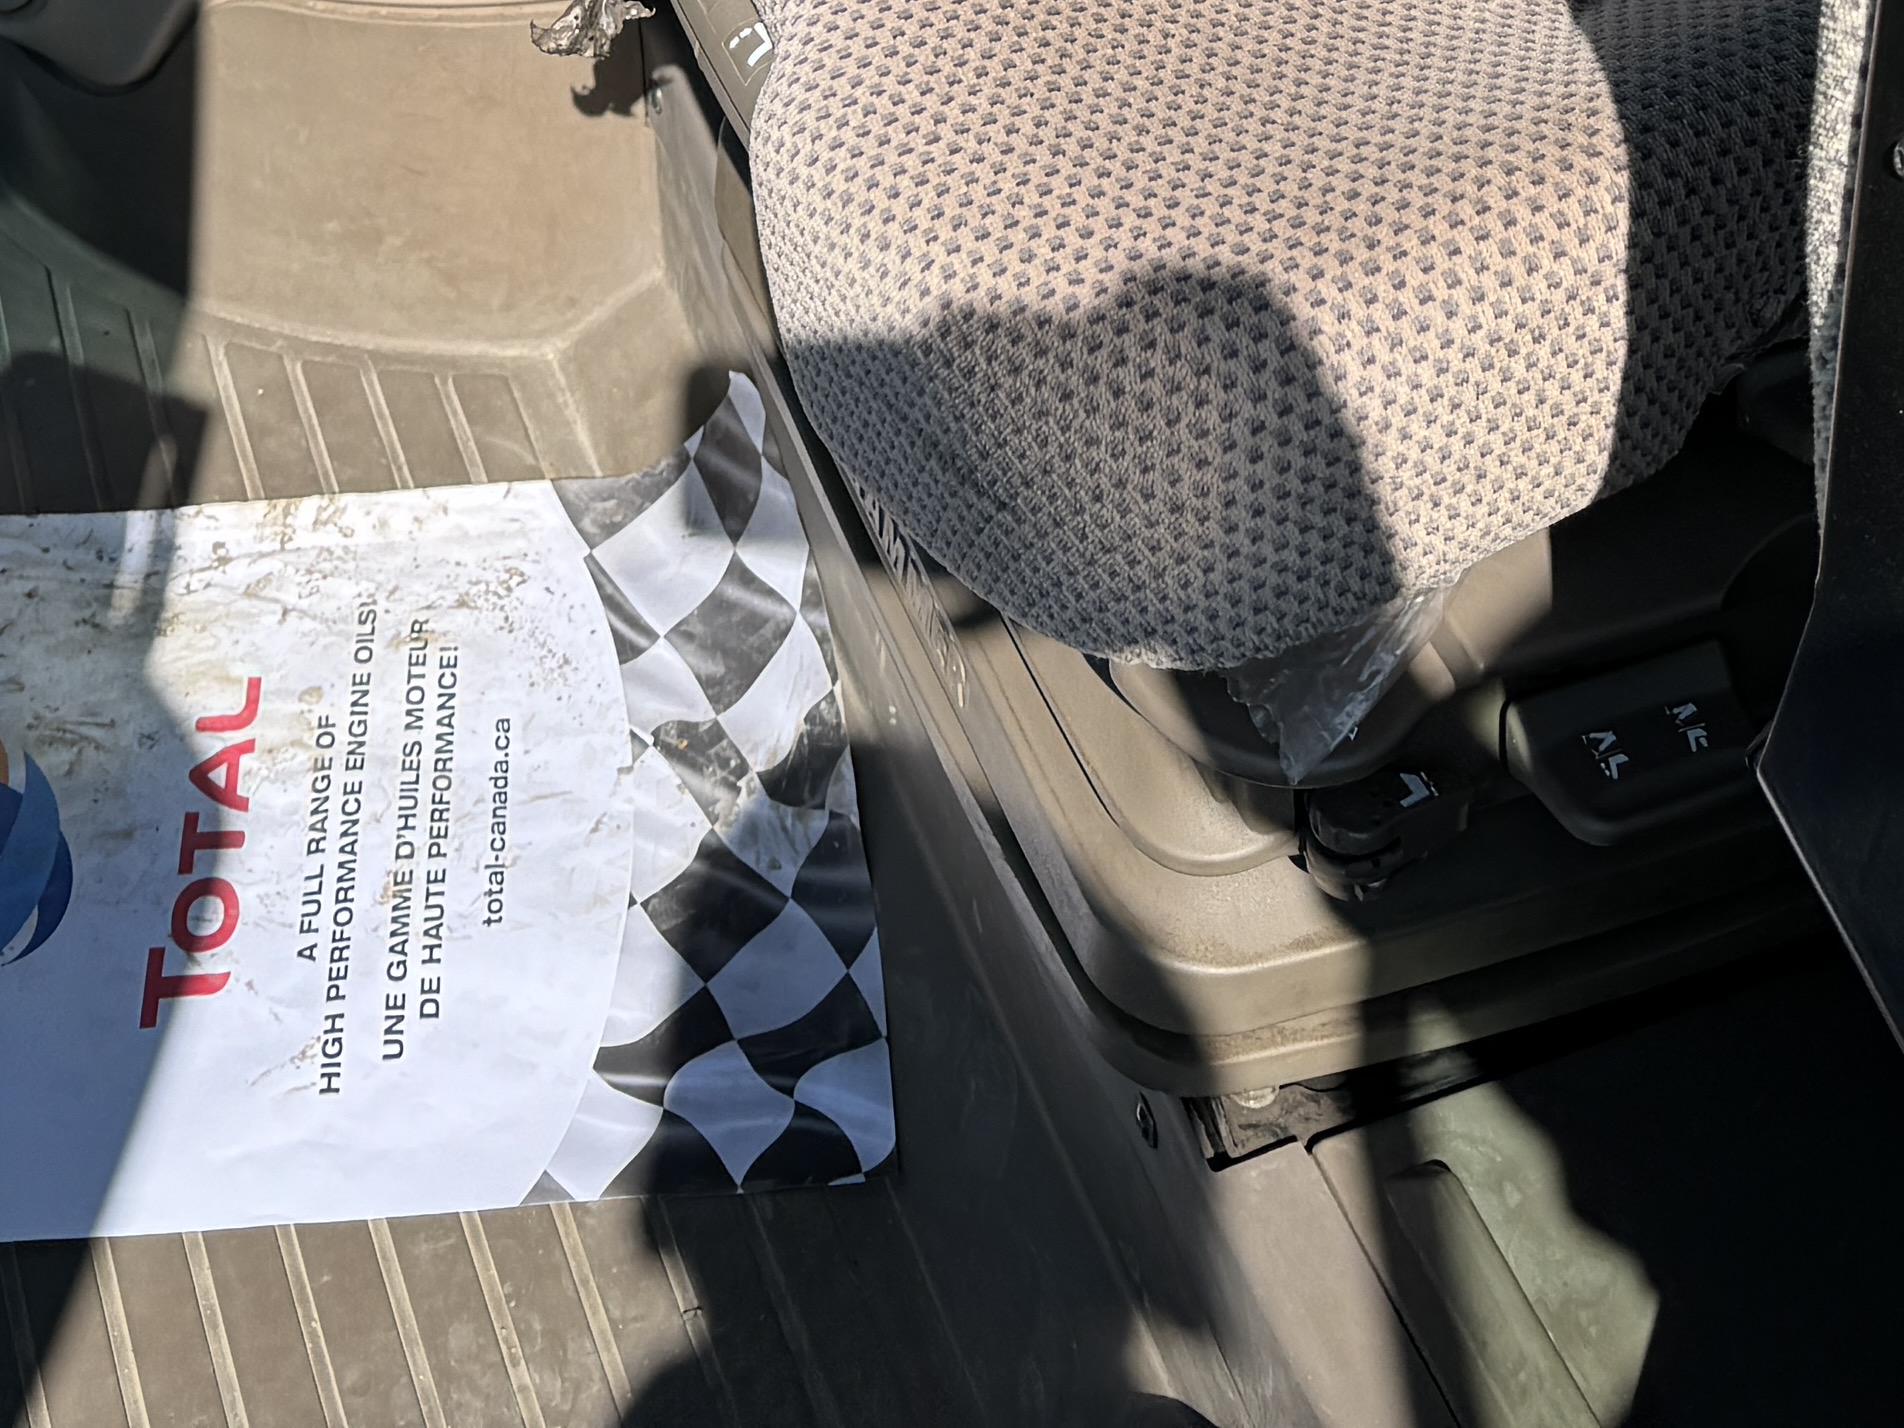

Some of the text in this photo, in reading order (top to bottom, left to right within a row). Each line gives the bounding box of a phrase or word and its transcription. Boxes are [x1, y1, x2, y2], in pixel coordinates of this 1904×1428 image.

[296, 714, 337, 962] A FULL RANGE OF
[345, 672, 371, 772] ENGINE
[382, 618, 429, 1061] UNE GAMME D'HUILES MOTEUR
[419, 645, 459, 1020] DE HAUTE PERFORMANCE!
[482, 717, 511, 928] total-canada.ca
[139, 676, 262, 1029] TOTAL
[326, 780, 363, 1003] PERFORMANCE
[319, 1012, 345, 1095] HIGH
